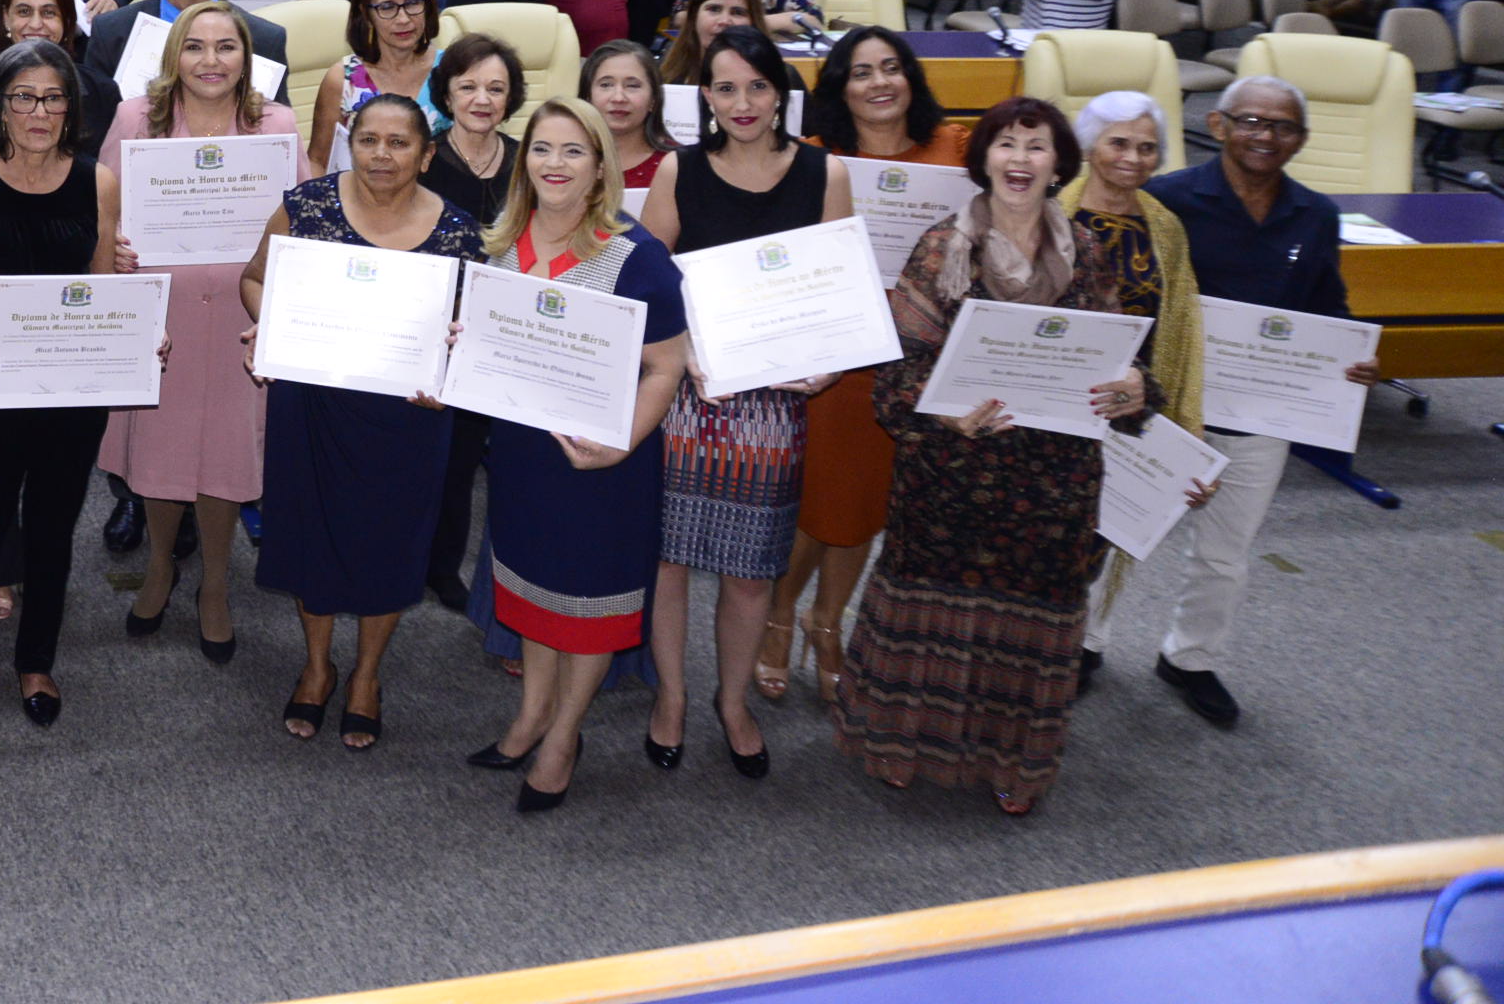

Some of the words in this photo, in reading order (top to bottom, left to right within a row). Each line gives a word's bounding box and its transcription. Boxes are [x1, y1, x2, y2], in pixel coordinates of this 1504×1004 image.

[150, 177, 184, 187] Diploma
[187, 176, 196, 185] de
[199, 175, 225, 184] Honra
[240, 172, 268, 183] Mérito
[11, 312, 48, 323] Diploma
[50, 312, 60, 321] de
[63, 311, 91, 322] Honra
[107, 310, 137, 321] Mérito
